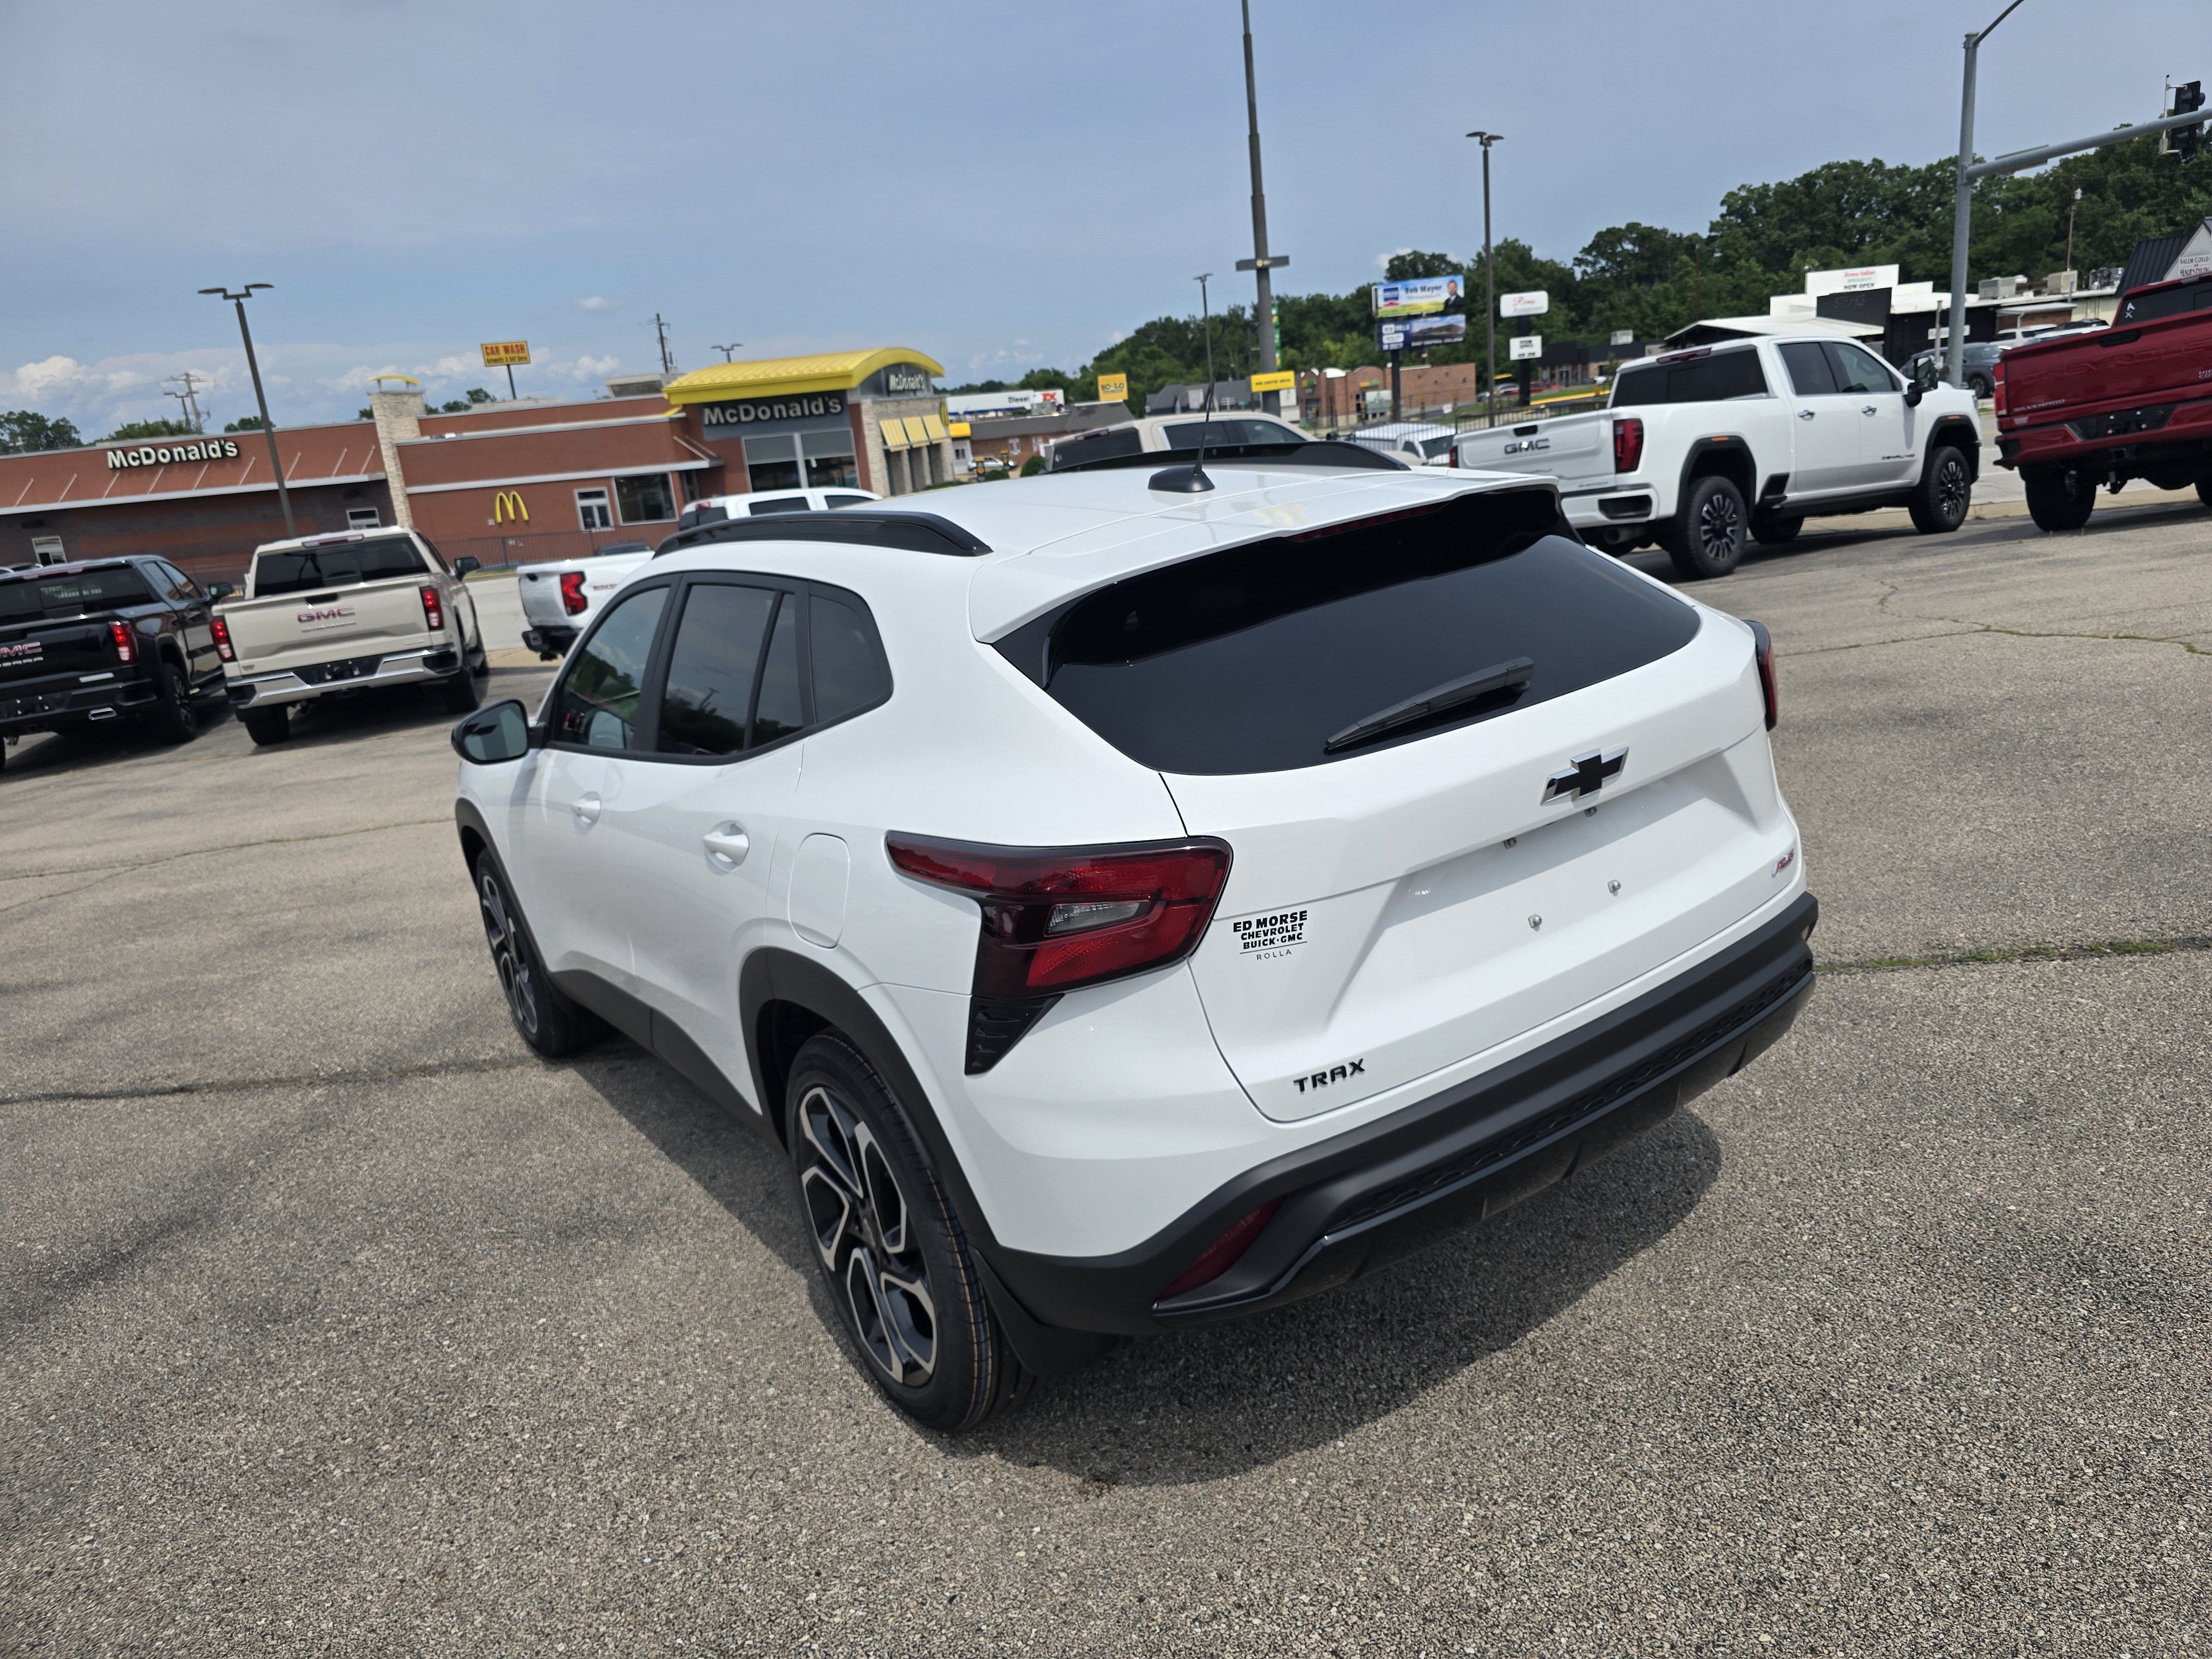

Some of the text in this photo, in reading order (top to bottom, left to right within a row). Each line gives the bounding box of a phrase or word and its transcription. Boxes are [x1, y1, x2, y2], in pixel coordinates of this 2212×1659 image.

[485, 344, 525, 356] CAR WASH
[703, 396, 842, 425] McDonald's
[106, 440, 238, 469] McDonald's
[1504, 438, 1551, 455] GMC
[297, 606, 356, 623] GMC
[0, 641, 42, 658] MC
[1233, 910, 1307, 932] ED MORSE
[1240, 922, 1304, 941] CHEVROLET
[1256, 949, 1292, 961] ROLLA
[1293, 1058, 1365, 1092] TRAX
